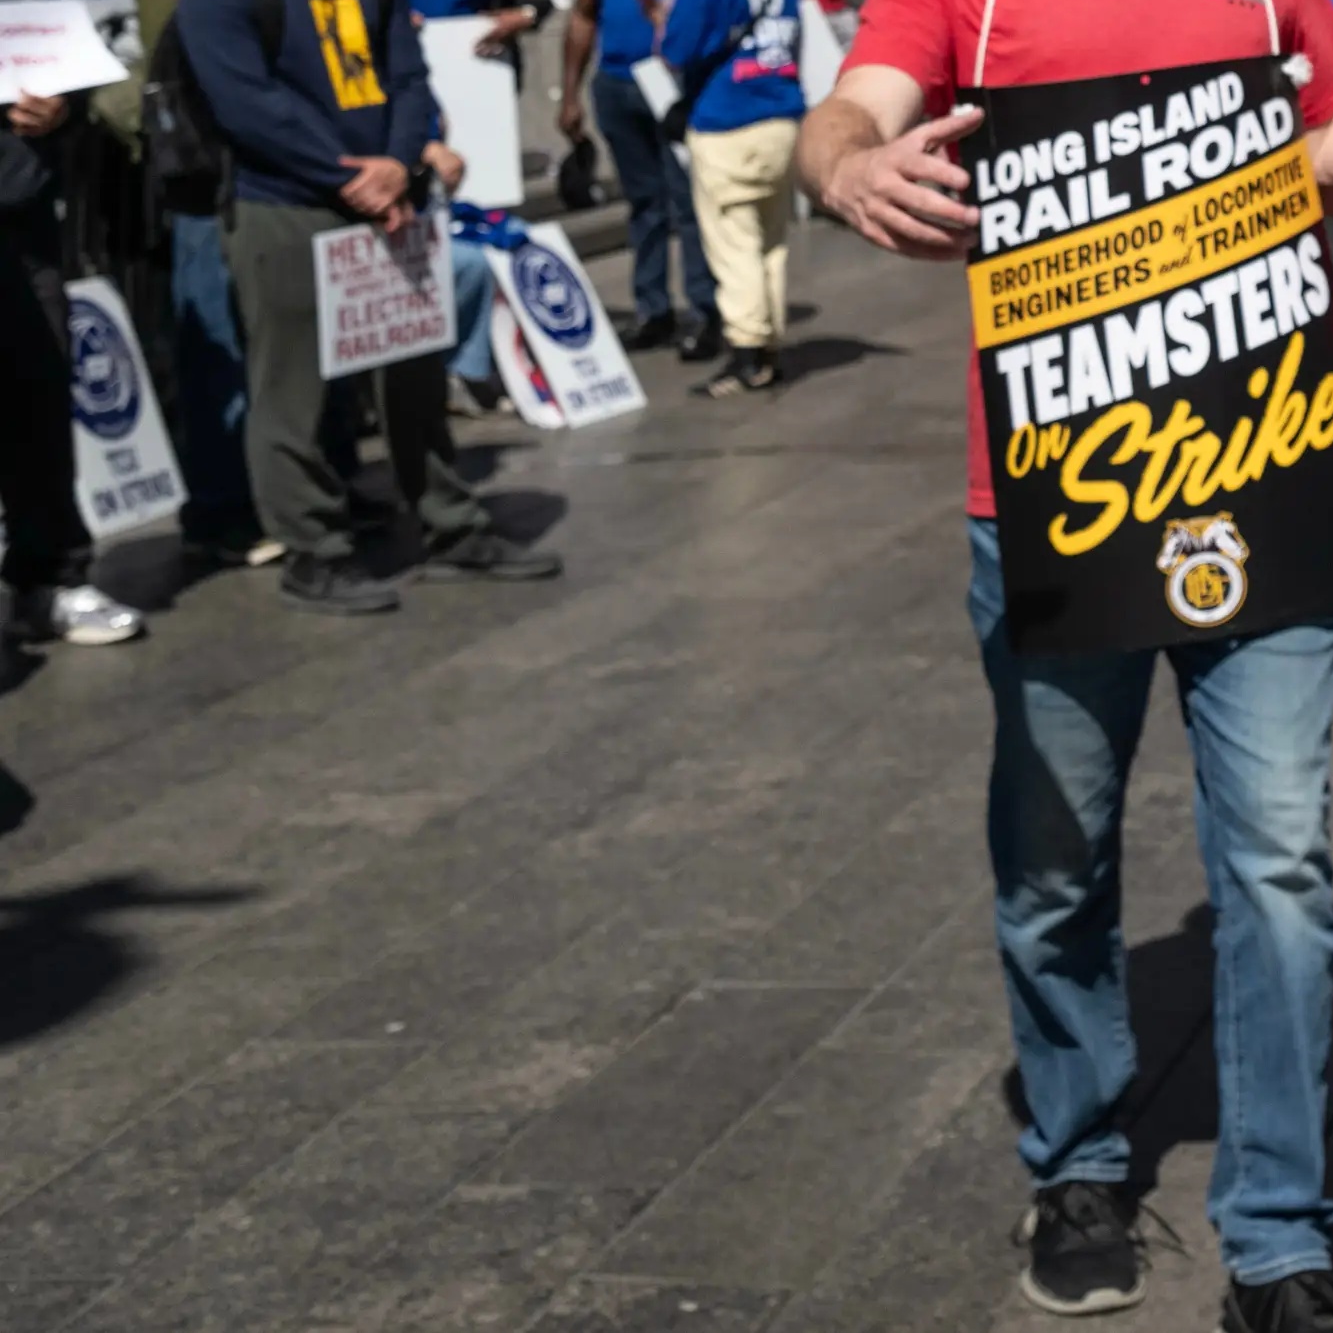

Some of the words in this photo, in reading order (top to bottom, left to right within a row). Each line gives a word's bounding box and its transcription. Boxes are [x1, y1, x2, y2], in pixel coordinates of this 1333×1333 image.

[977, 131, 1087, 200] LONG
[1097, 72, 1244, 163] ISLAND
[980, 168, 1131, 254] RAIL
[1143, 97, 1294, 201] ROAD
[990, 220, 1163, 297] BROTHERHOOD
[1173, 213, 1190, 245] of
[1193, 154, 1304, 229] LOCOMOTIVE
[992, 260, 1152, 329] ENGINEERS
[1159, 252, 1194, 277] and
[1199, 192, 1310, 261] TRAINMEN
[996, 233, 1330, 431] TEAMSTERS
[1007, 423, 1070, 478] On
